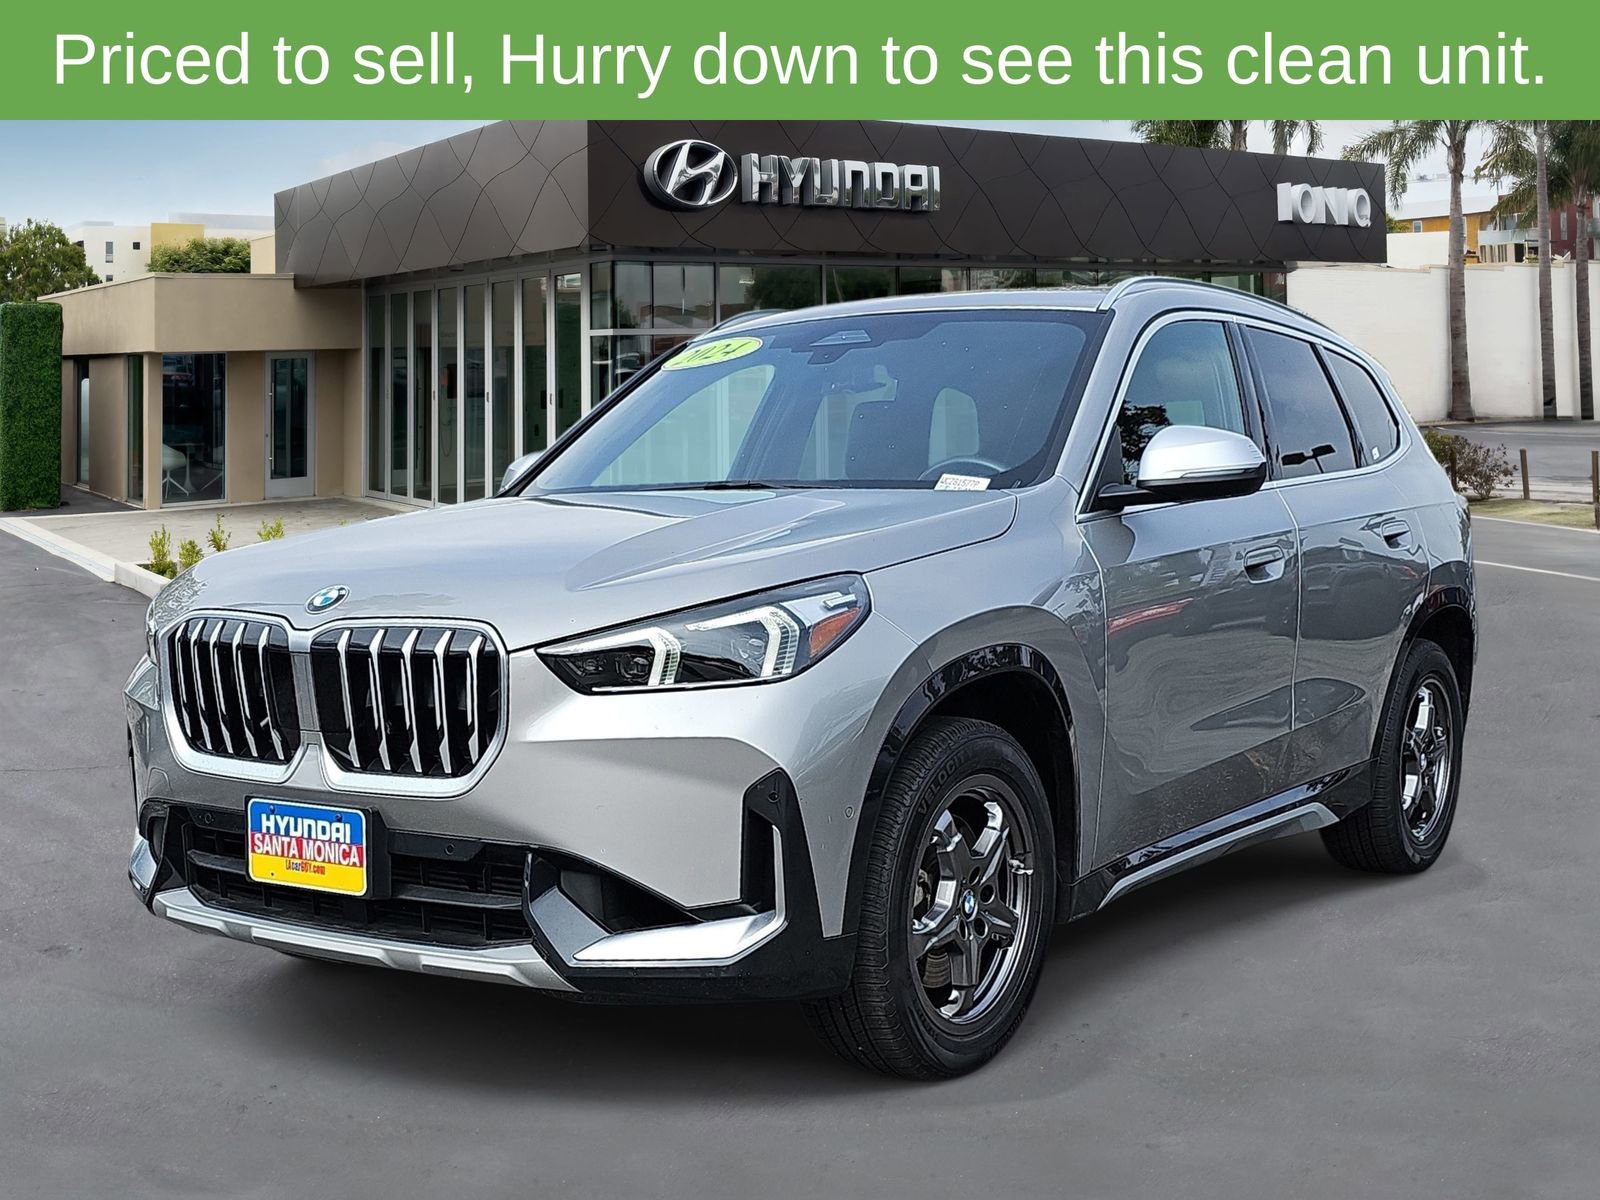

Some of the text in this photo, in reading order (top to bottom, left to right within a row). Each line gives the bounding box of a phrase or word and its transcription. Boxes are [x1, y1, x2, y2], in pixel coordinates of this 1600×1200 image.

[741, 152, 940, 211] HYUNDAI
[1277, 182, 1371, 228] IONIQ
[671, 340, 752, 366] 2024
[261, 813, 351, 844] HYUNDAI
[254, 833, 361, 867] SANTA MONICA
